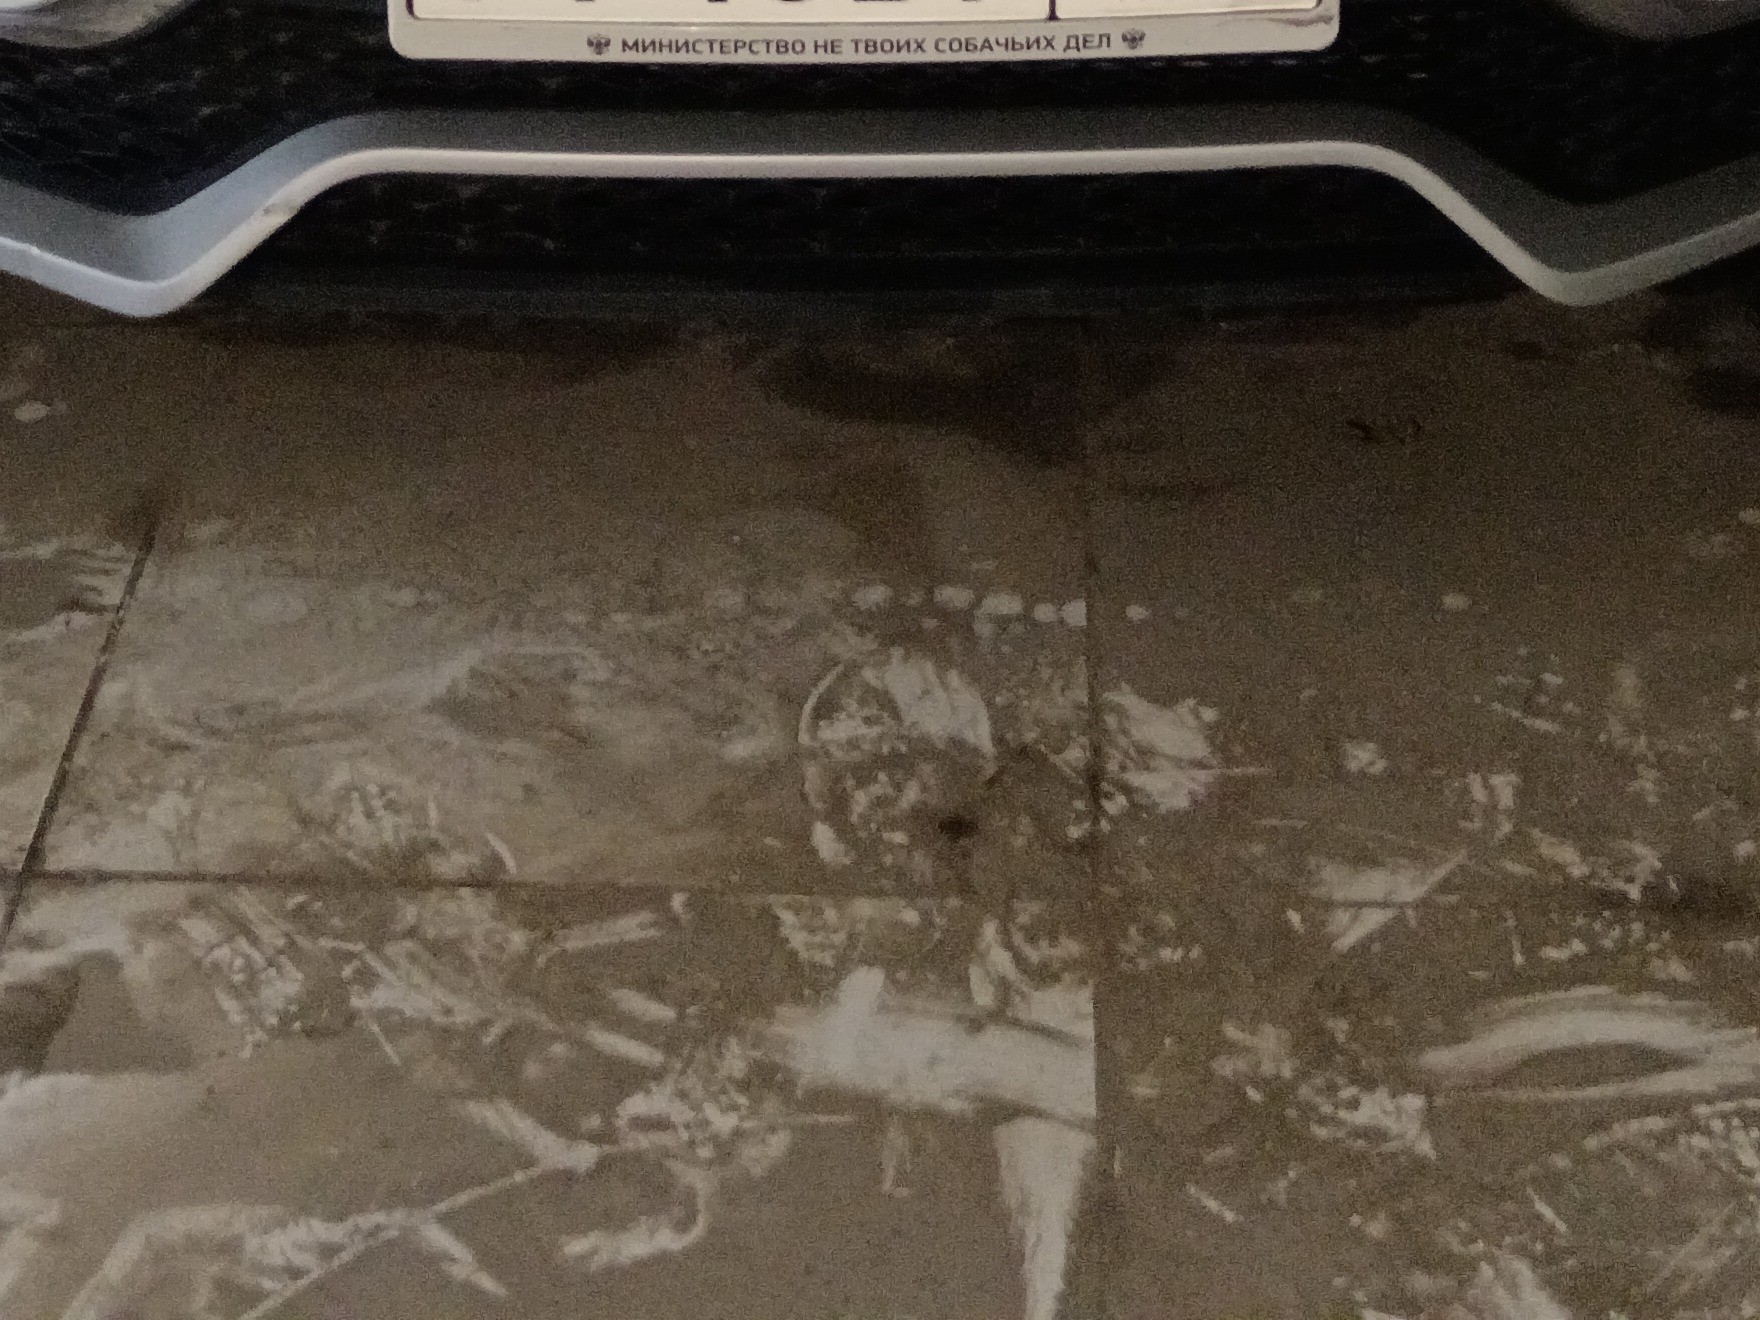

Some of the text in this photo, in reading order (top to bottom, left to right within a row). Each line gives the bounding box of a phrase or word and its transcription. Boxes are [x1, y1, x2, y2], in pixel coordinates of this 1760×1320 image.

[621, 32, 1111, 55] МИНИСТЕРСТВО НЕ ТВОИХ СОБАЧЬИХ ДЕЛ
